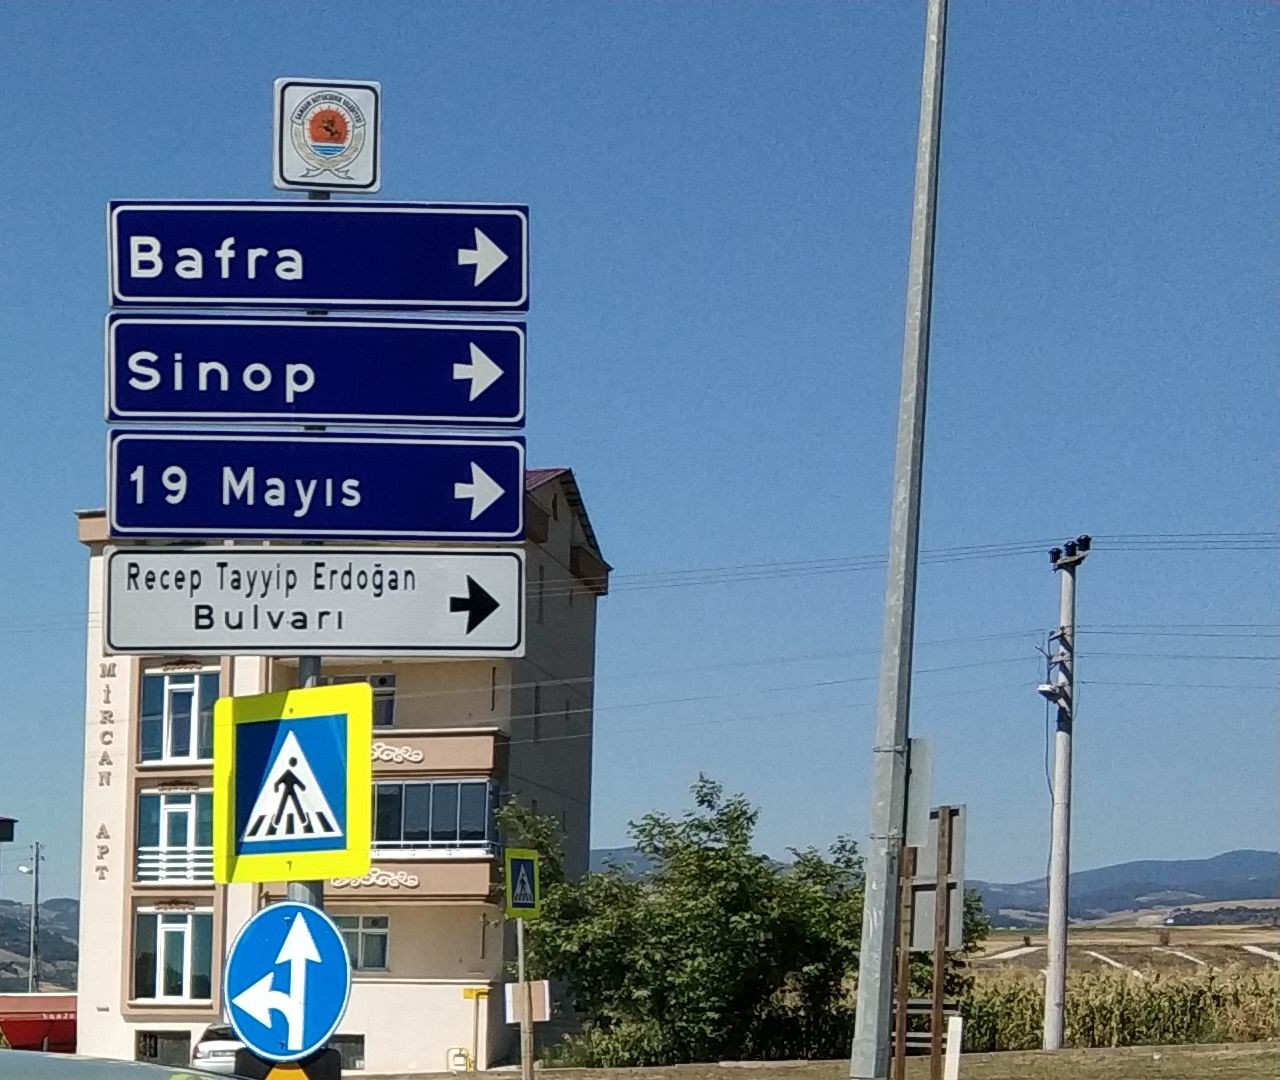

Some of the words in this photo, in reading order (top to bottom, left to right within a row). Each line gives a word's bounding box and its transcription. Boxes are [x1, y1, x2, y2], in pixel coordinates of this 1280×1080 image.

[128, 235, 303, 281] Bafra
[127, 350, 315, 403] Sinop
[129, 465, 188, 505] 19
[221, 466, 362, 518] Mayıs
[126, 561, 203, 599] Recep
[216, 561, 298, 599] Tayyip
[312, 561, 416, 599] Erdoğan
[194, 604, 343, 630] Bulvarı
